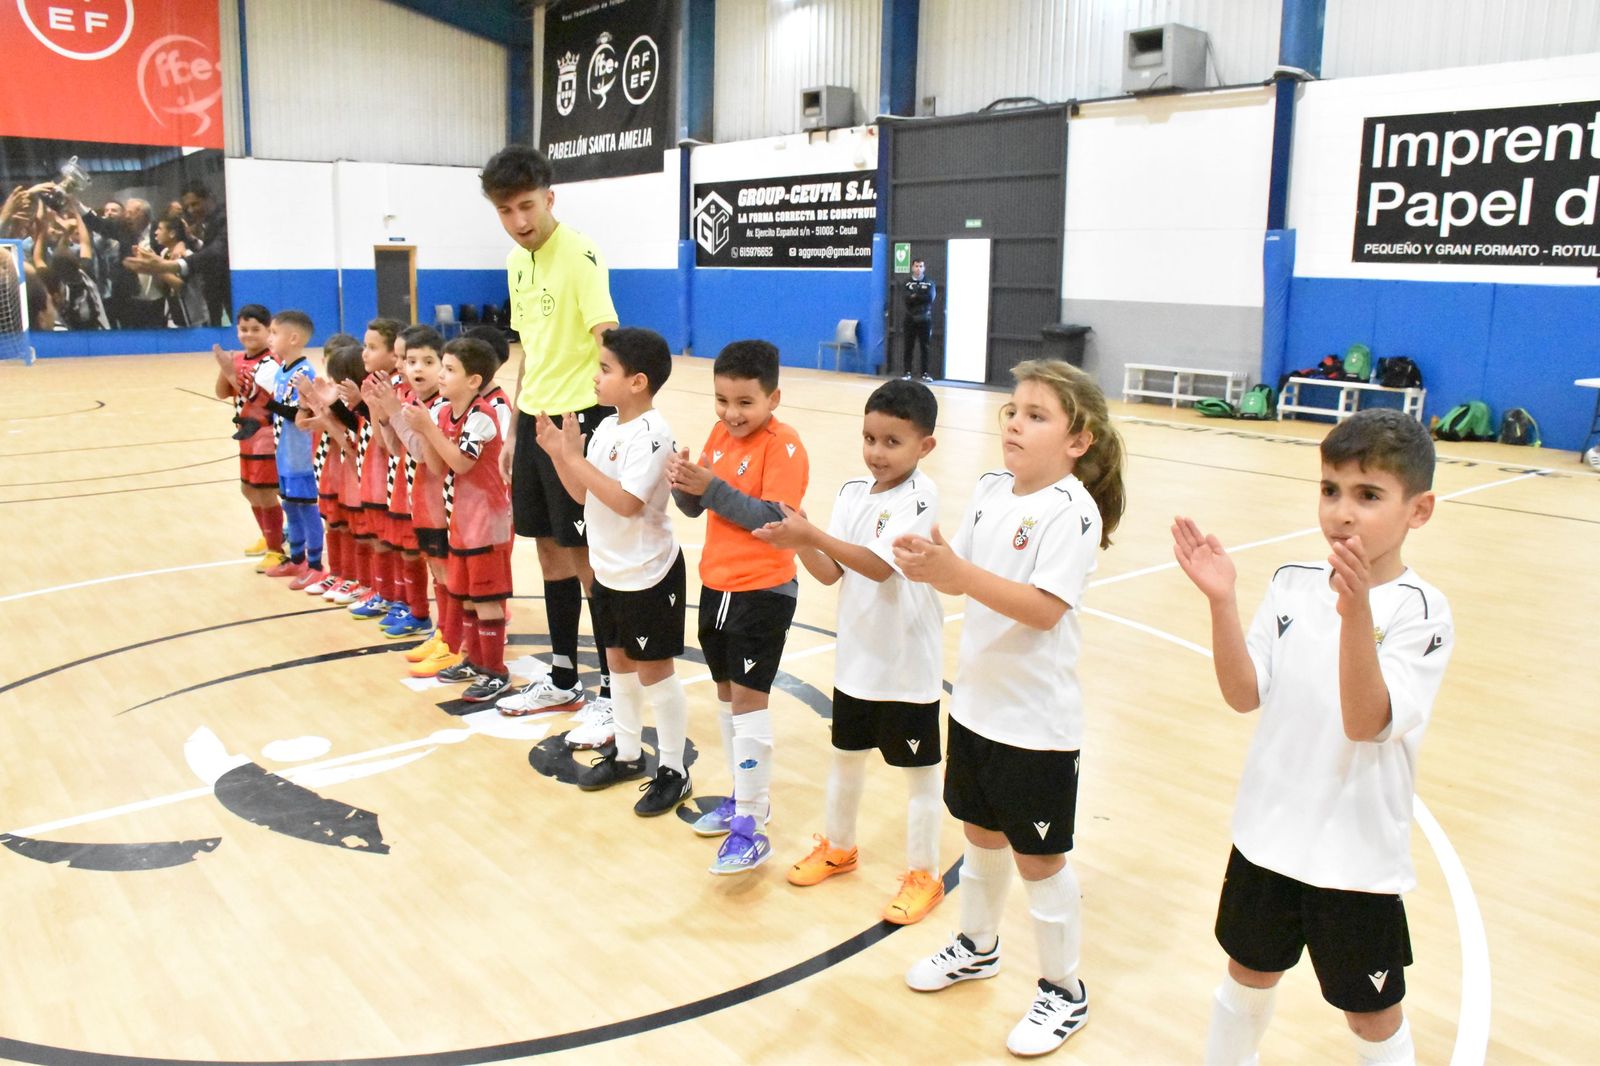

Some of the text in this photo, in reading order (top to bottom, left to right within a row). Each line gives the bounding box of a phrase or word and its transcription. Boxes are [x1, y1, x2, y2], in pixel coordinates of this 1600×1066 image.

[548, 127, 652, 160] PABELLÓN SANTA AMELIA
[1371, 111, 1600, 177] Imprent
[737, 180, 877, 207] GROUP-CEUTA S.L.
[1367, 175, 1600, 238] Papel d
[738, 213, 748, 224] LA
[749, 212, 774, 223] FORMA
[775, 210, 816, 222] CORRECTA
[817, 209, 829, 221] DE
[776, 227, 799, 239] Español
[815, 226, 834, 236] 51002
[839, 225, 858, 235] Ceuta
[1363, 241, 1422, 255] PEQUEÑO
[1424, 244, 1433, 255] Y
[1435, 244, 1472, 255] GRAN
[1474, 244, 1540, 256] FORMATO
[1551, 245, 1600, 257] ROTUL
